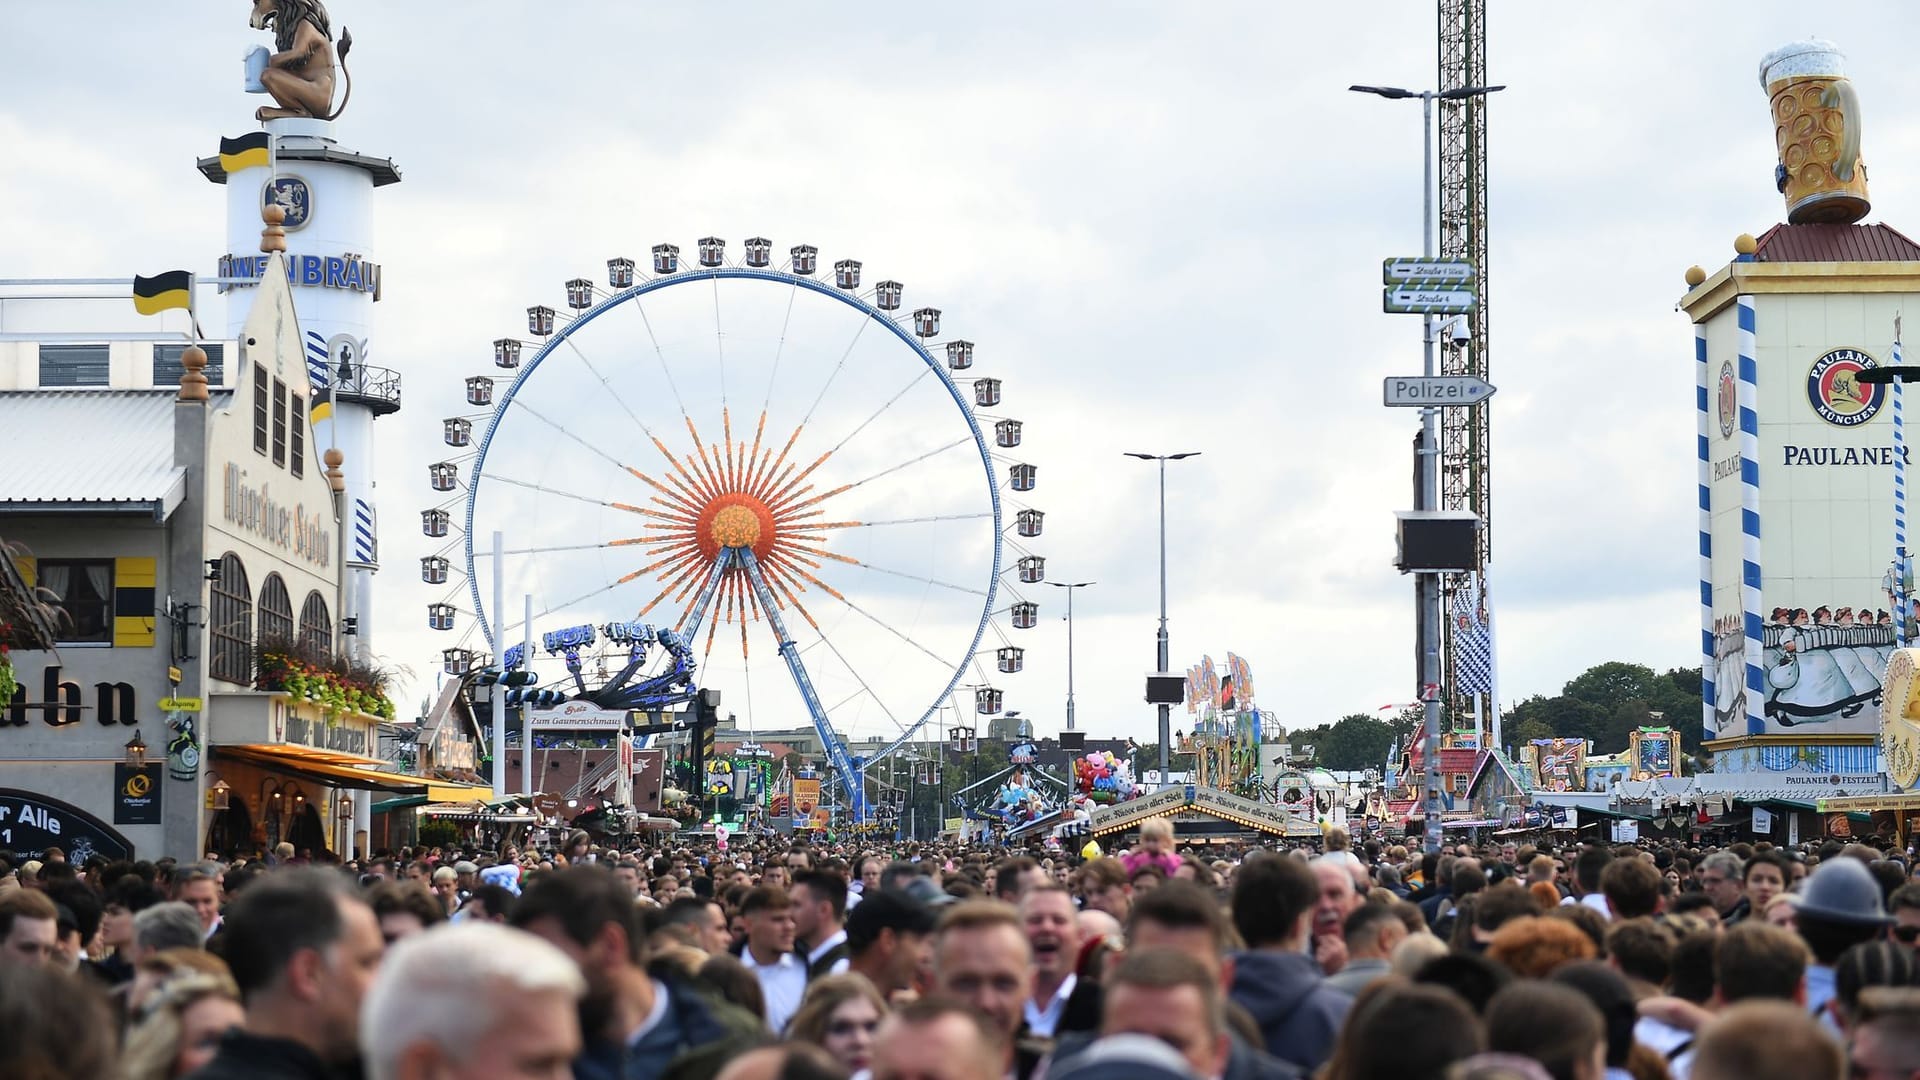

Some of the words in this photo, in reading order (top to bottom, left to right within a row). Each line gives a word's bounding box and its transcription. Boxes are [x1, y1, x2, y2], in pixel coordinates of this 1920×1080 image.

[1810, 350, 1879, 380] PAULANE
[1396, 381, 1464, 398] Polizei
[1817, 404, 1877, 425] MÜNCHEN
[1783, 445, 1912, 465] PAULANER
[531, 717, 550, 725] Zum
[552, 716, 621, 726] Gaumenschmaus
[1786, 776, 1828, 784] PAULANER
[1842, 776, 1879, 784] FESTZELT
[18, 804, 61, 835] Alle
